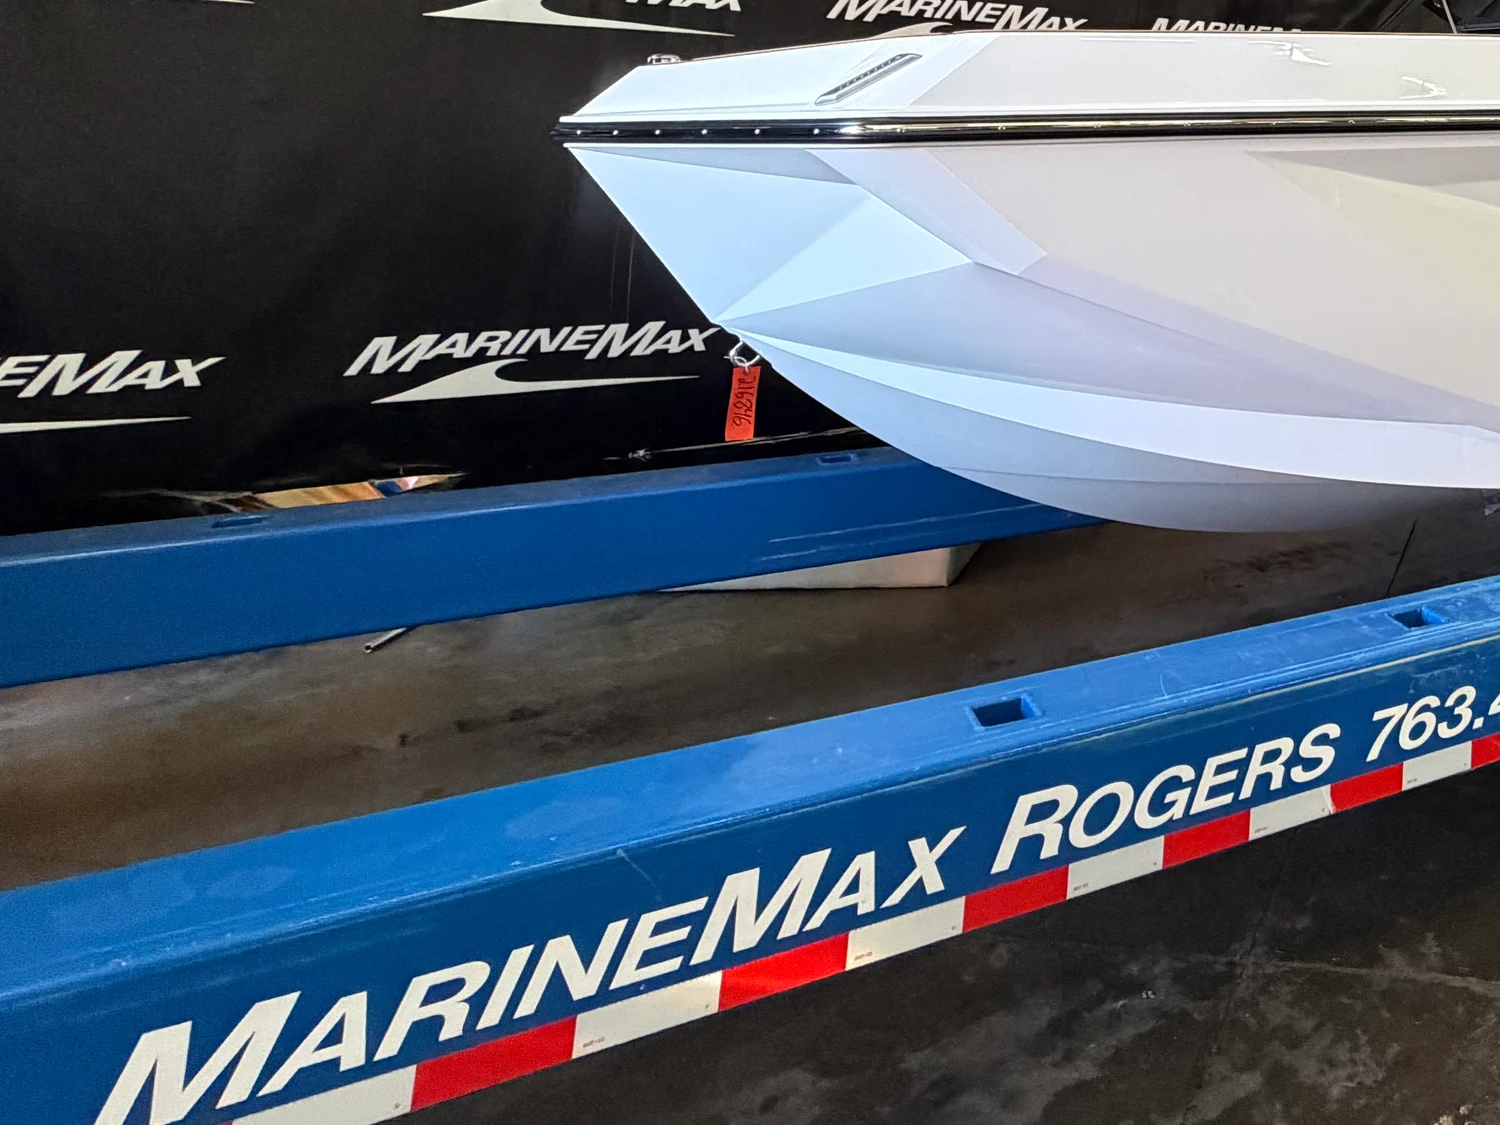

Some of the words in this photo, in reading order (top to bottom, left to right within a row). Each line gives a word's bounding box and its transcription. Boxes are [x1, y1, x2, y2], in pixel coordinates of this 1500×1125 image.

[344, 320, 721, 377] MARINEMAX
[94, 826, 967, 1125] MARINEMAX
[990, 723, 1341, 875] ROGERS
